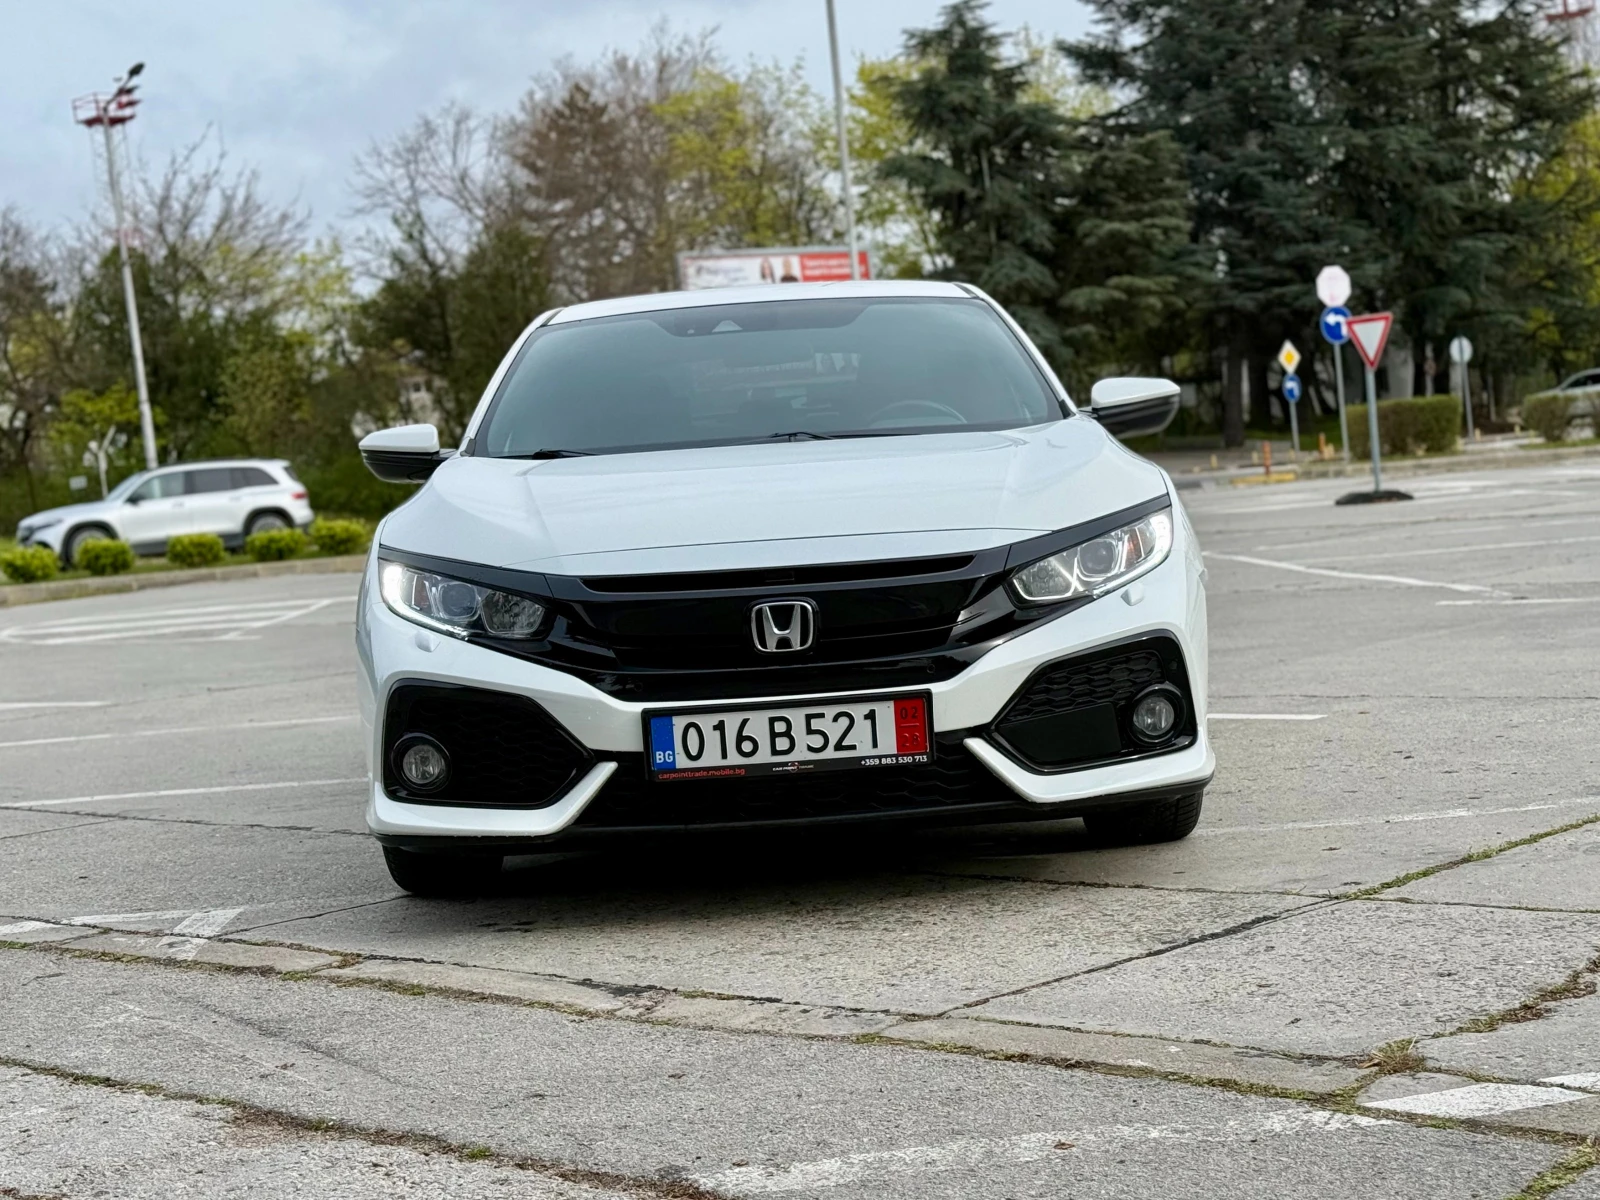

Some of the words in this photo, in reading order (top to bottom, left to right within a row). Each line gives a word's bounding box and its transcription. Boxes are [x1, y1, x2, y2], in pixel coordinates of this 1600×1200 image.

[900, 706, 918, 719] 02
[655, 751, 673, 763] BG
[881, 757, 897, 765] 883
[898, 756, 913, 764] 530
[658, 768, 745, 779] carpointtrade.mobile.bg
